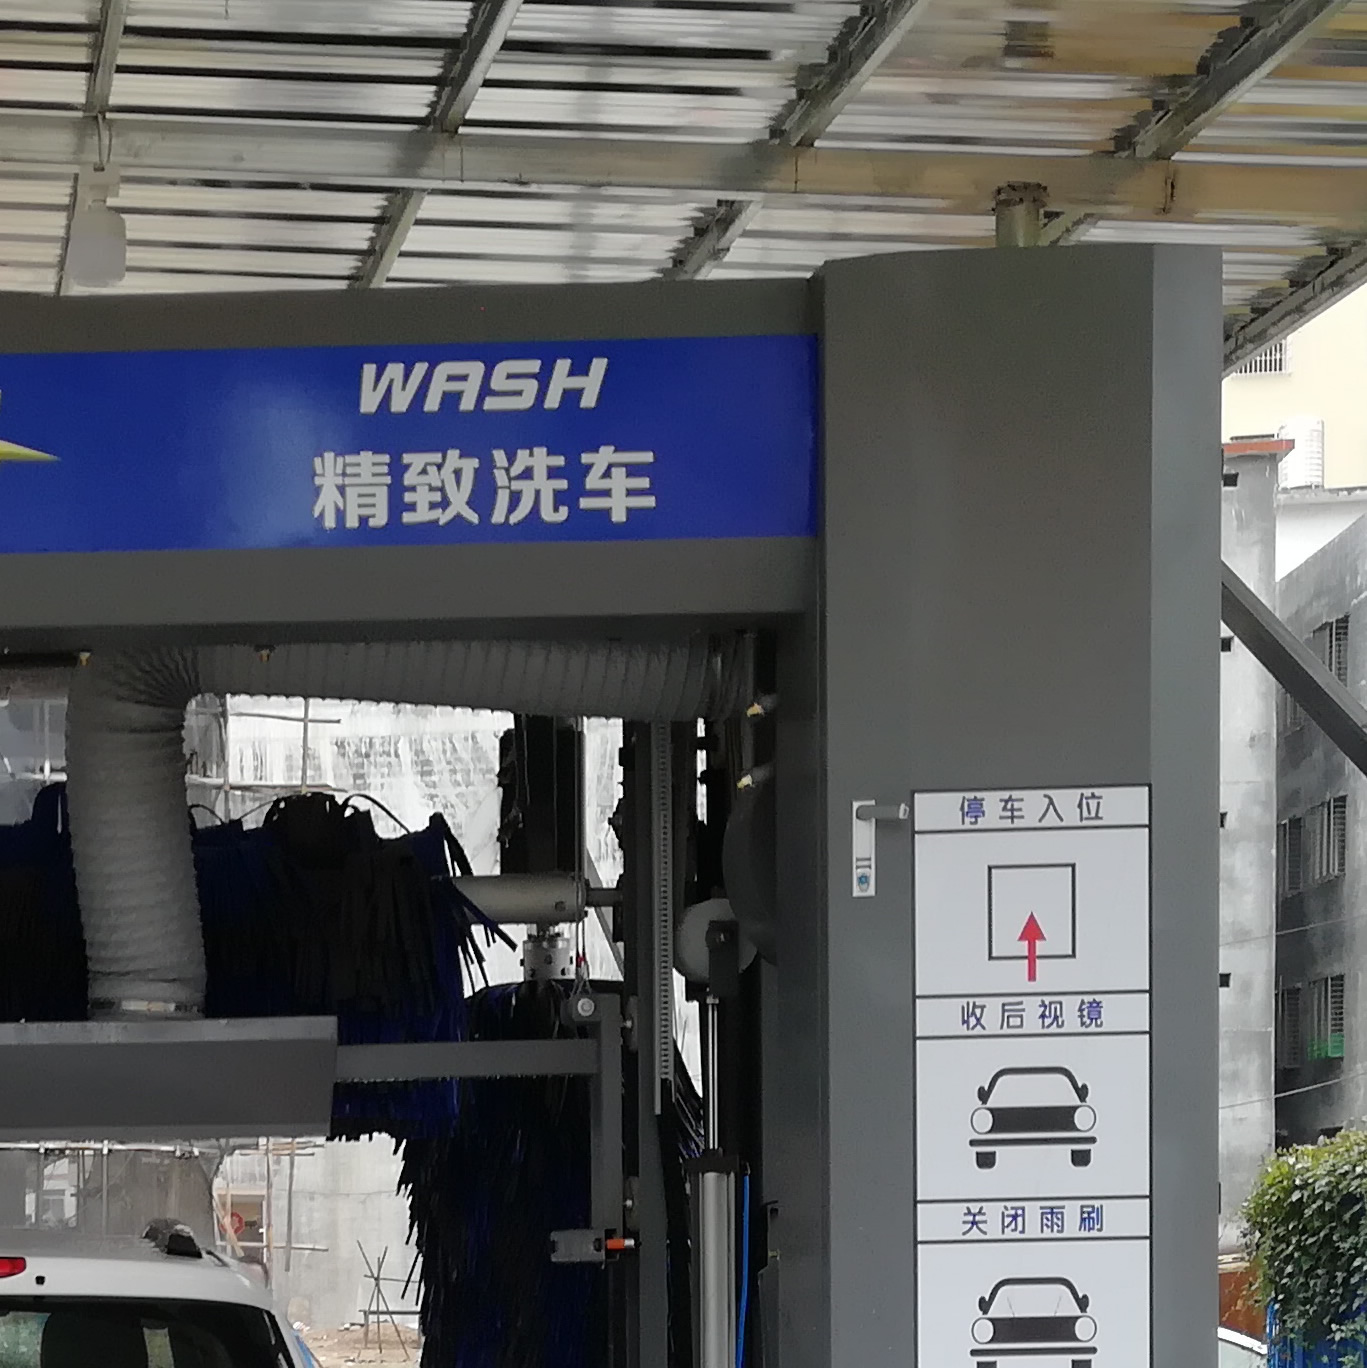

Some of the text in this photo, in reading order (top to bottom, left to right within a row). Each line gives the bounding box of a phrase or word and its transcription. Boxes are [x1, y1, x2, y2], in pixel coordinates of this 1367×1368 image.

[359, 357, 609, 415] WASH
[312, 445, 657, 530] 精致洗车
[959, 792, 1104, 826] 停车入位
[960, 999, 1104, 1032] 收后视镜
[961, 1205, 1105, 1237] 关闭雨刷
